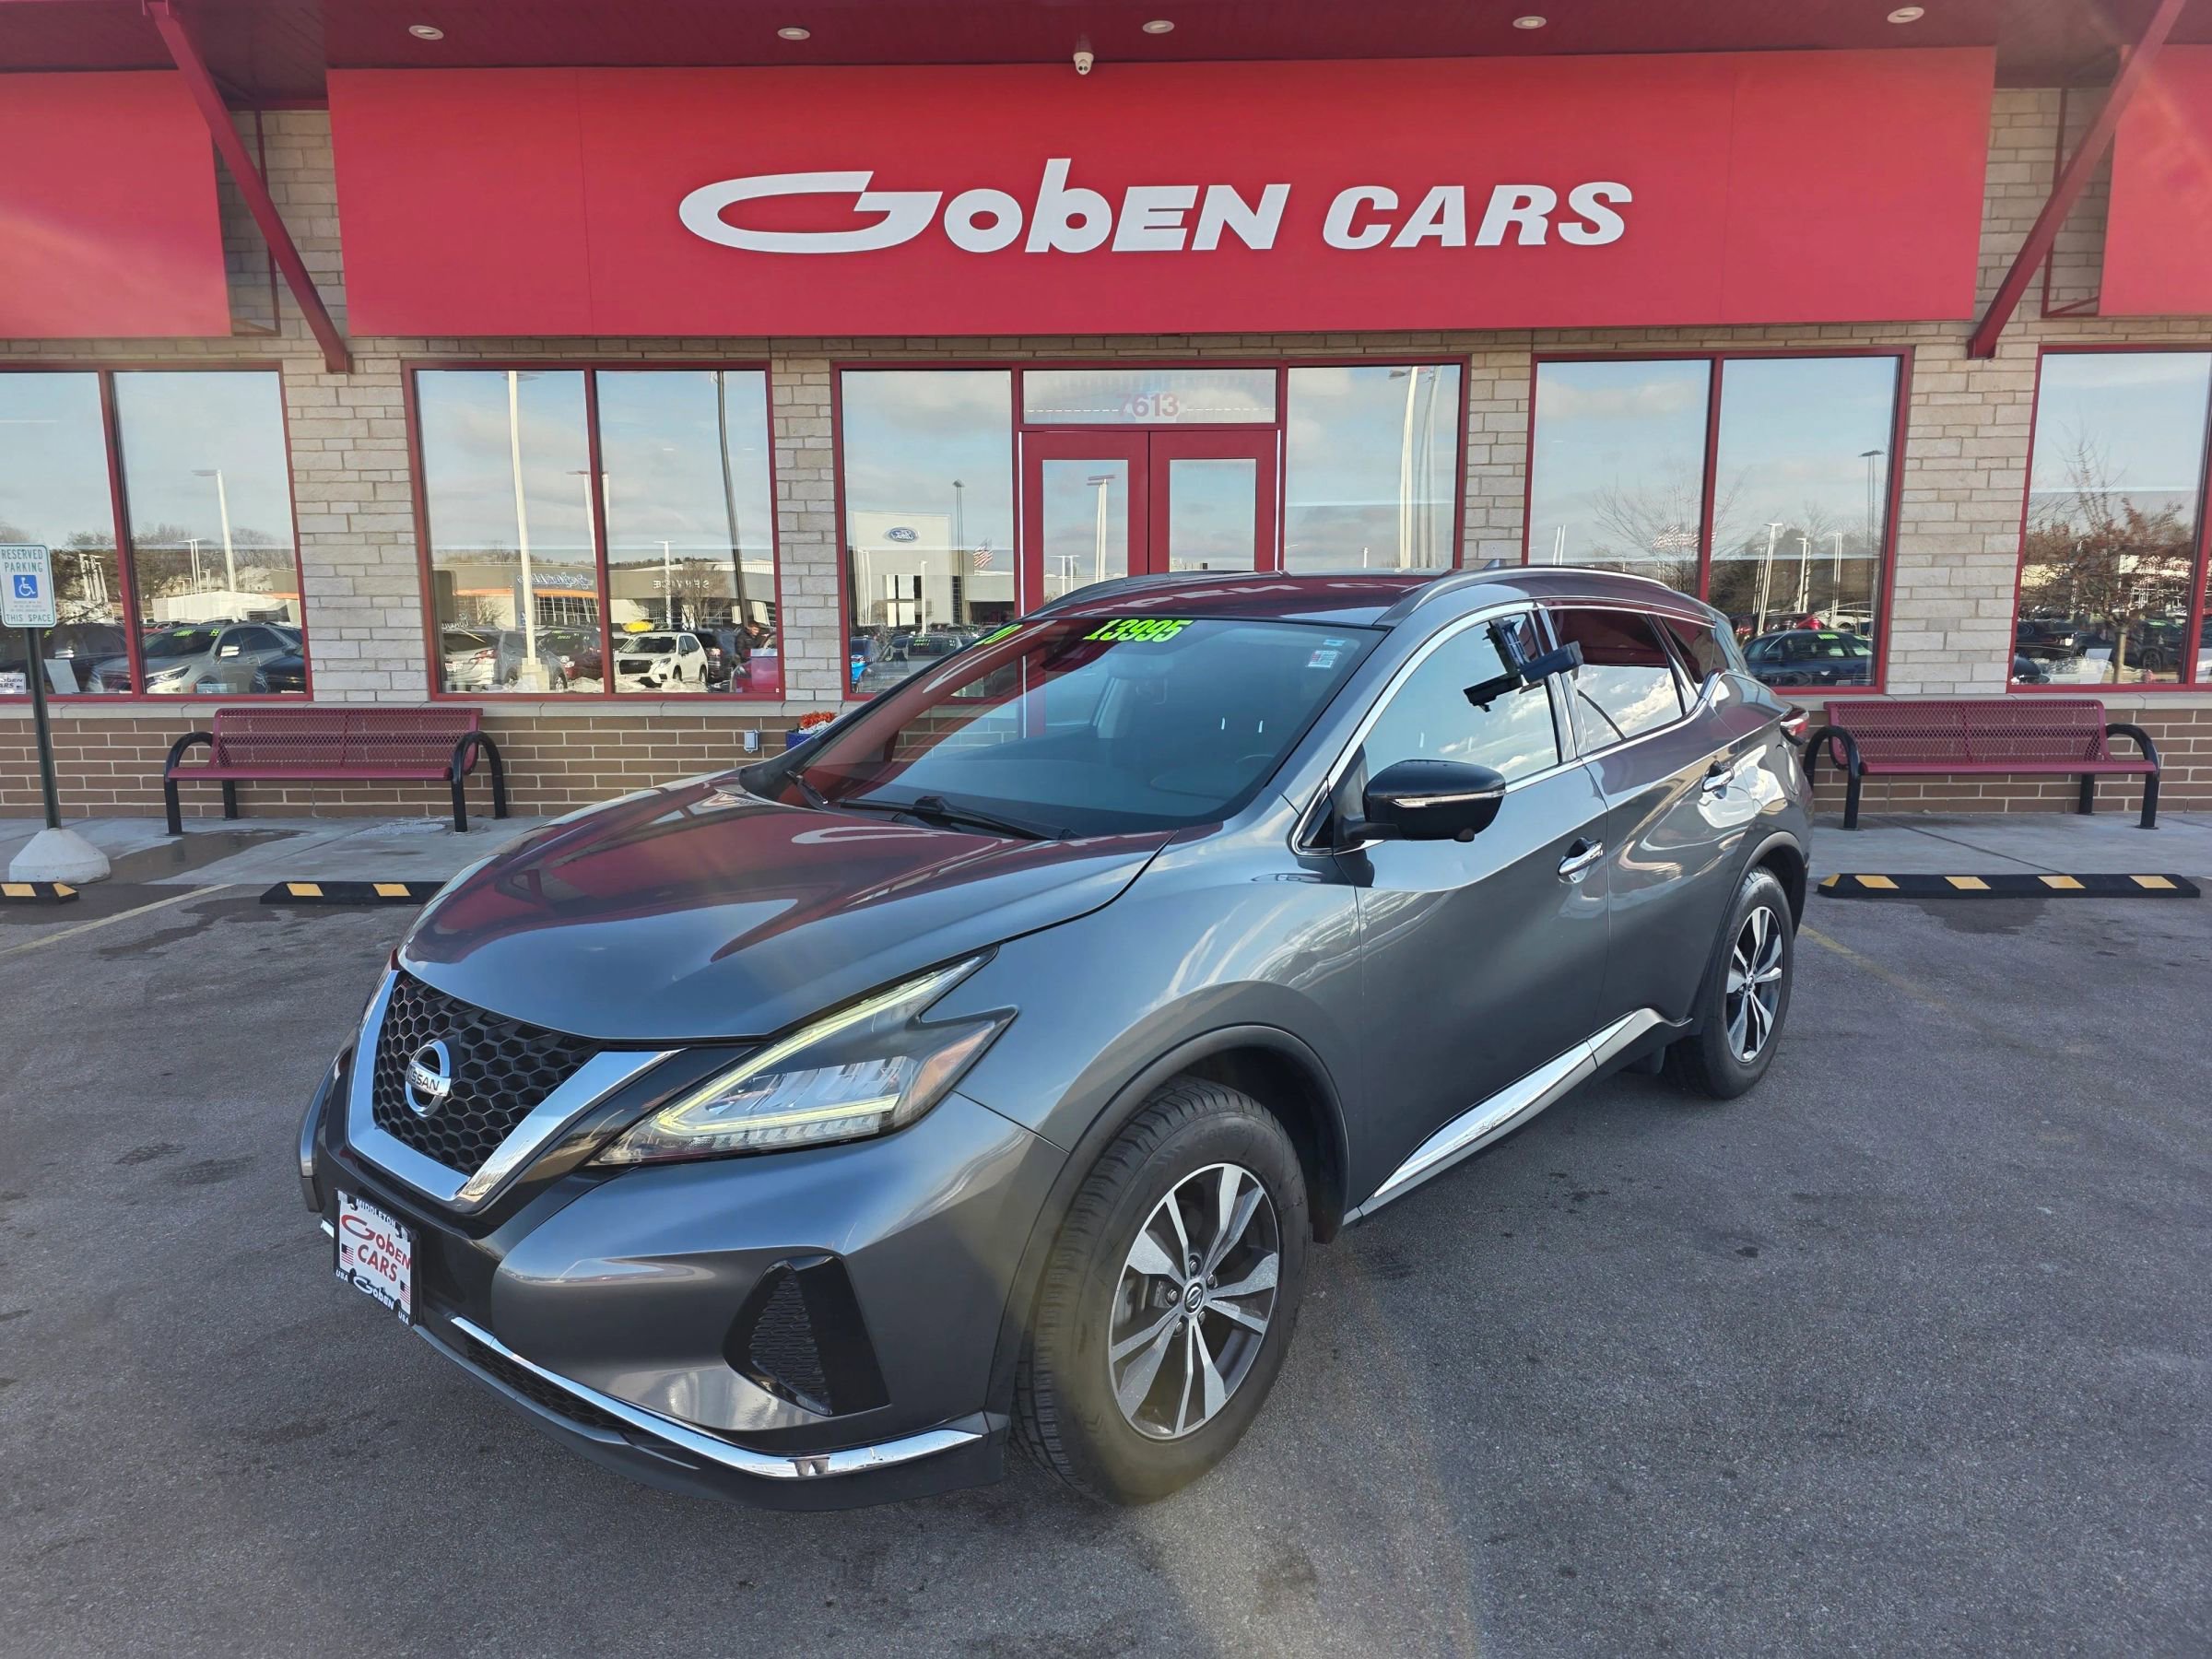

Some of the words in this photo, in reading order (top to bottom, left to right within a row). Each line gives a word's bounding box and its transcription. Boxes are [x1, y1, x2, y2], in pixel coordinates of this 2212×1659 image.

[1323, 182, 1632, 250] CARS
[1116, 393, 1179, 418] 7613
[1, 548, 43, 559] RESERVED
[5, 561, 43, 572] PARKING
[6, 614, 23, 622] THIS
[28, 614, 53, 622] SPACE
[1082, 618, 1194, 642] 13995
[356, 1198, 396, 1229] MIDDLETON
[358, 1244, 398, 1282] CARS
[335, 1269, 349, 1283] USA
[398, 1310, 409, 1326] USA
